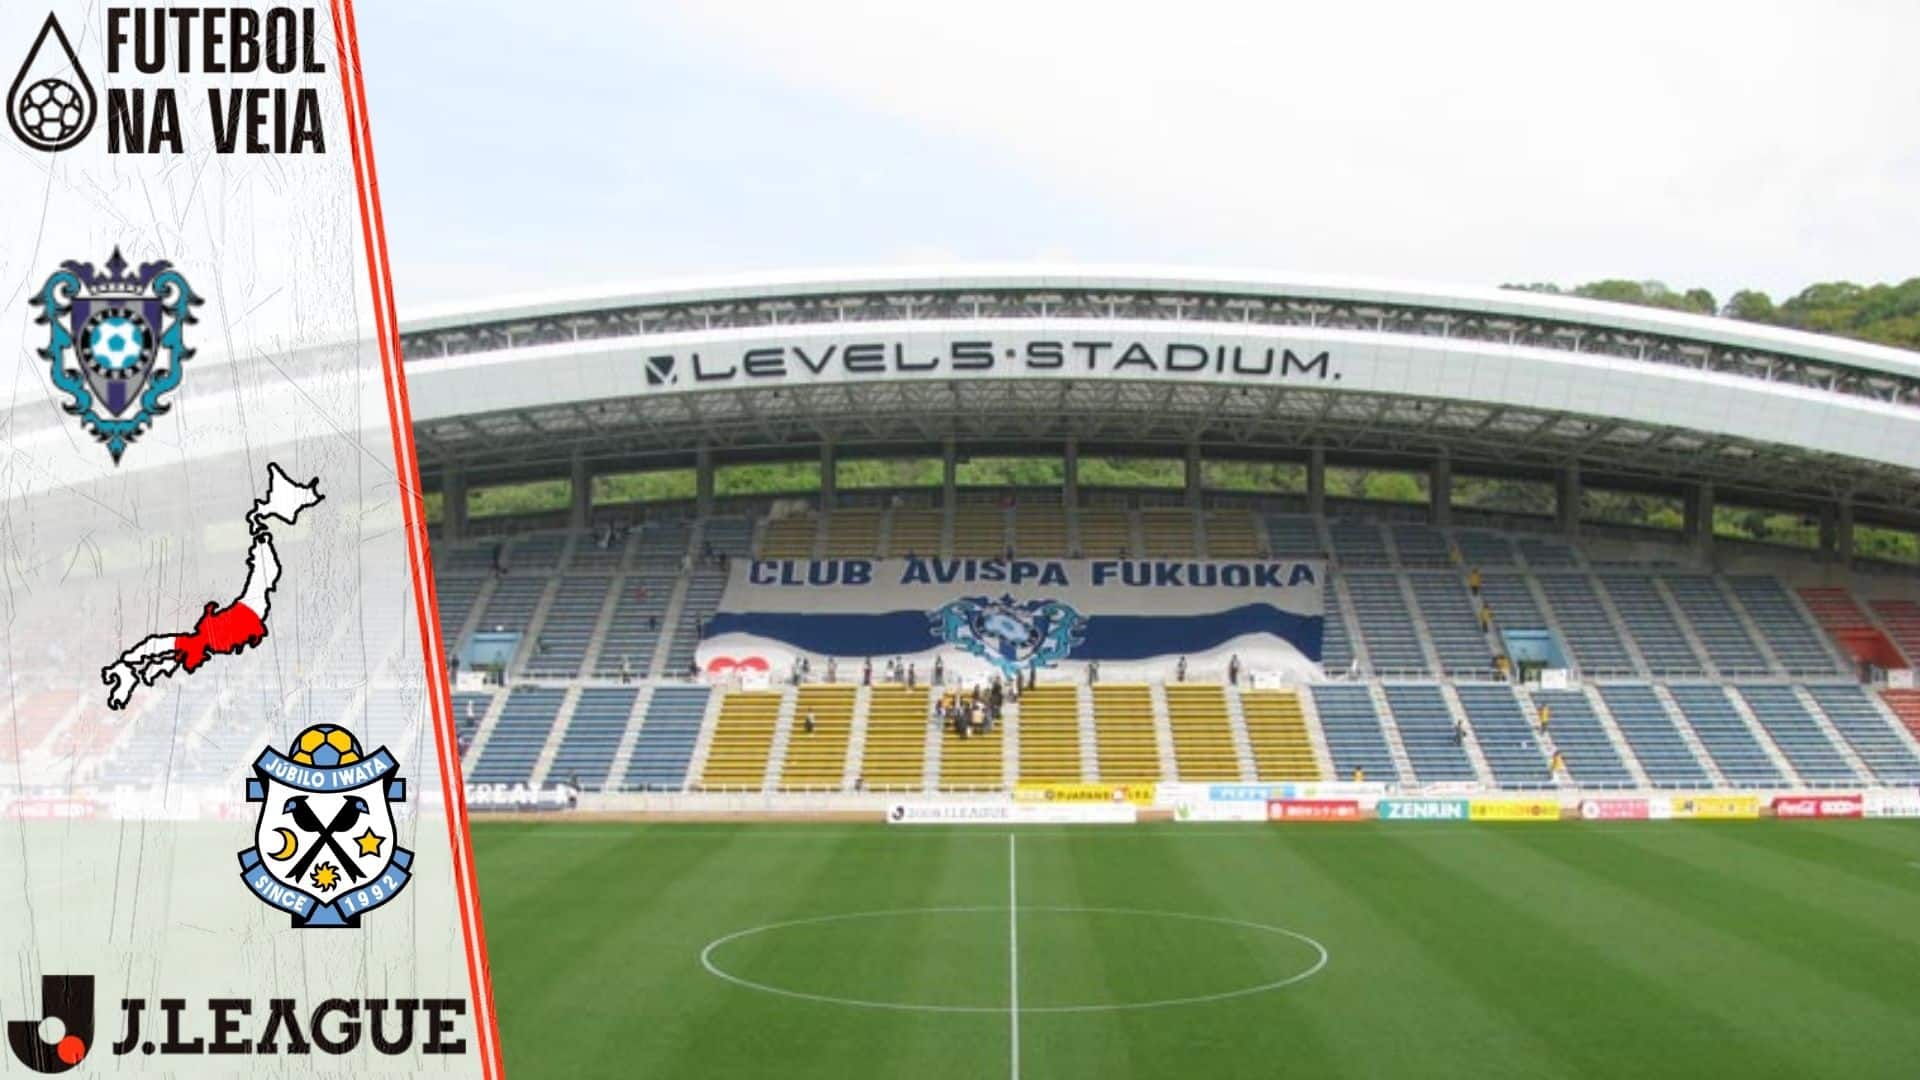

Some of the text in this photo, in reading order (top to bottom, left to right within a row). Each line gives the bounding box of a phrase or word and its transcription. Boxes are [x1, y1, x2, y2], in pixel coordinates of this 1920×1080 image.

[749, 557, 1314, 588] CLUB AVISPA FUKUOKA
[1389, 801, 1462, 819] ZENRIN
